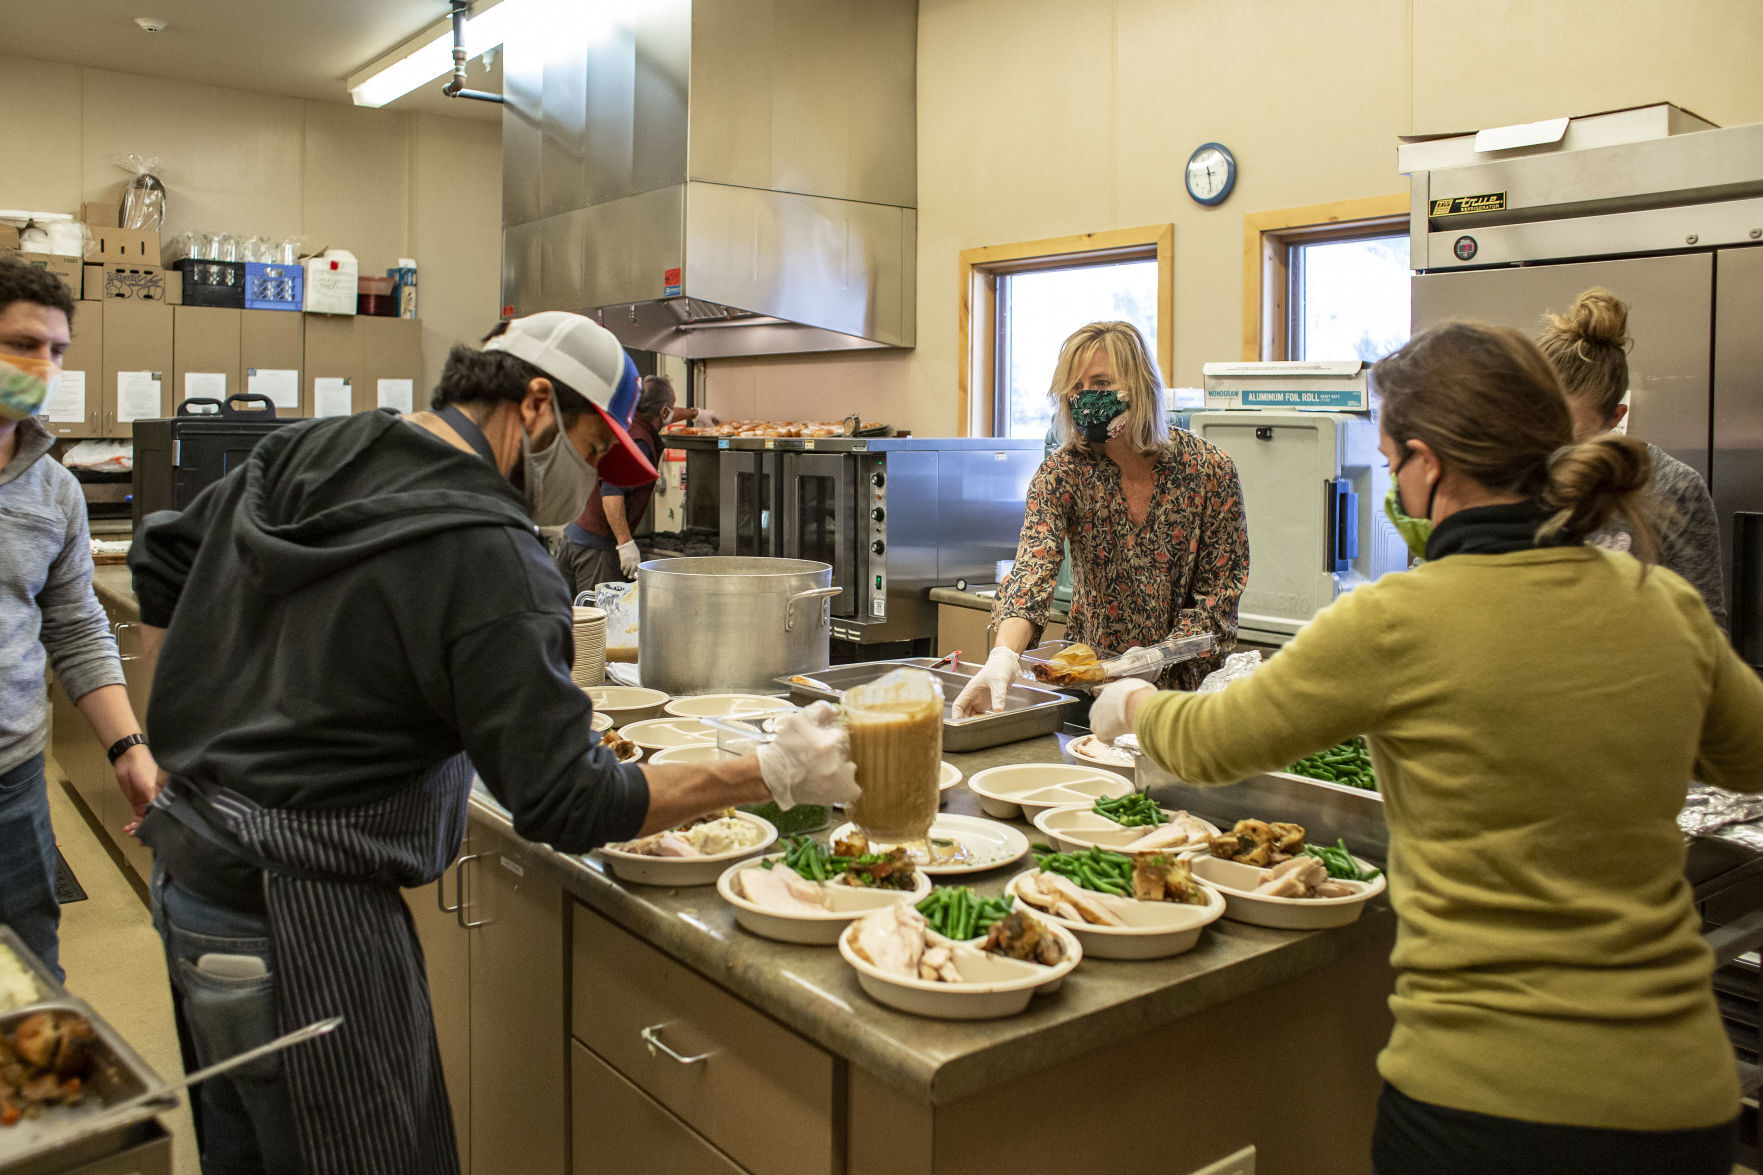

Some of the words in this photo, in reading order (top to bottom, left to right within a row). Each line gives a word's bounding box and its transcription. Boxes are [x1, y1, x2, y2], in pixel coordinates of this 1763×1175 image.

[1248, 392, 1284, 402] ALUMINUM
[1285, 392, 1300, 402] FOIL
[1302, 392, 1320, 402] ROLL
